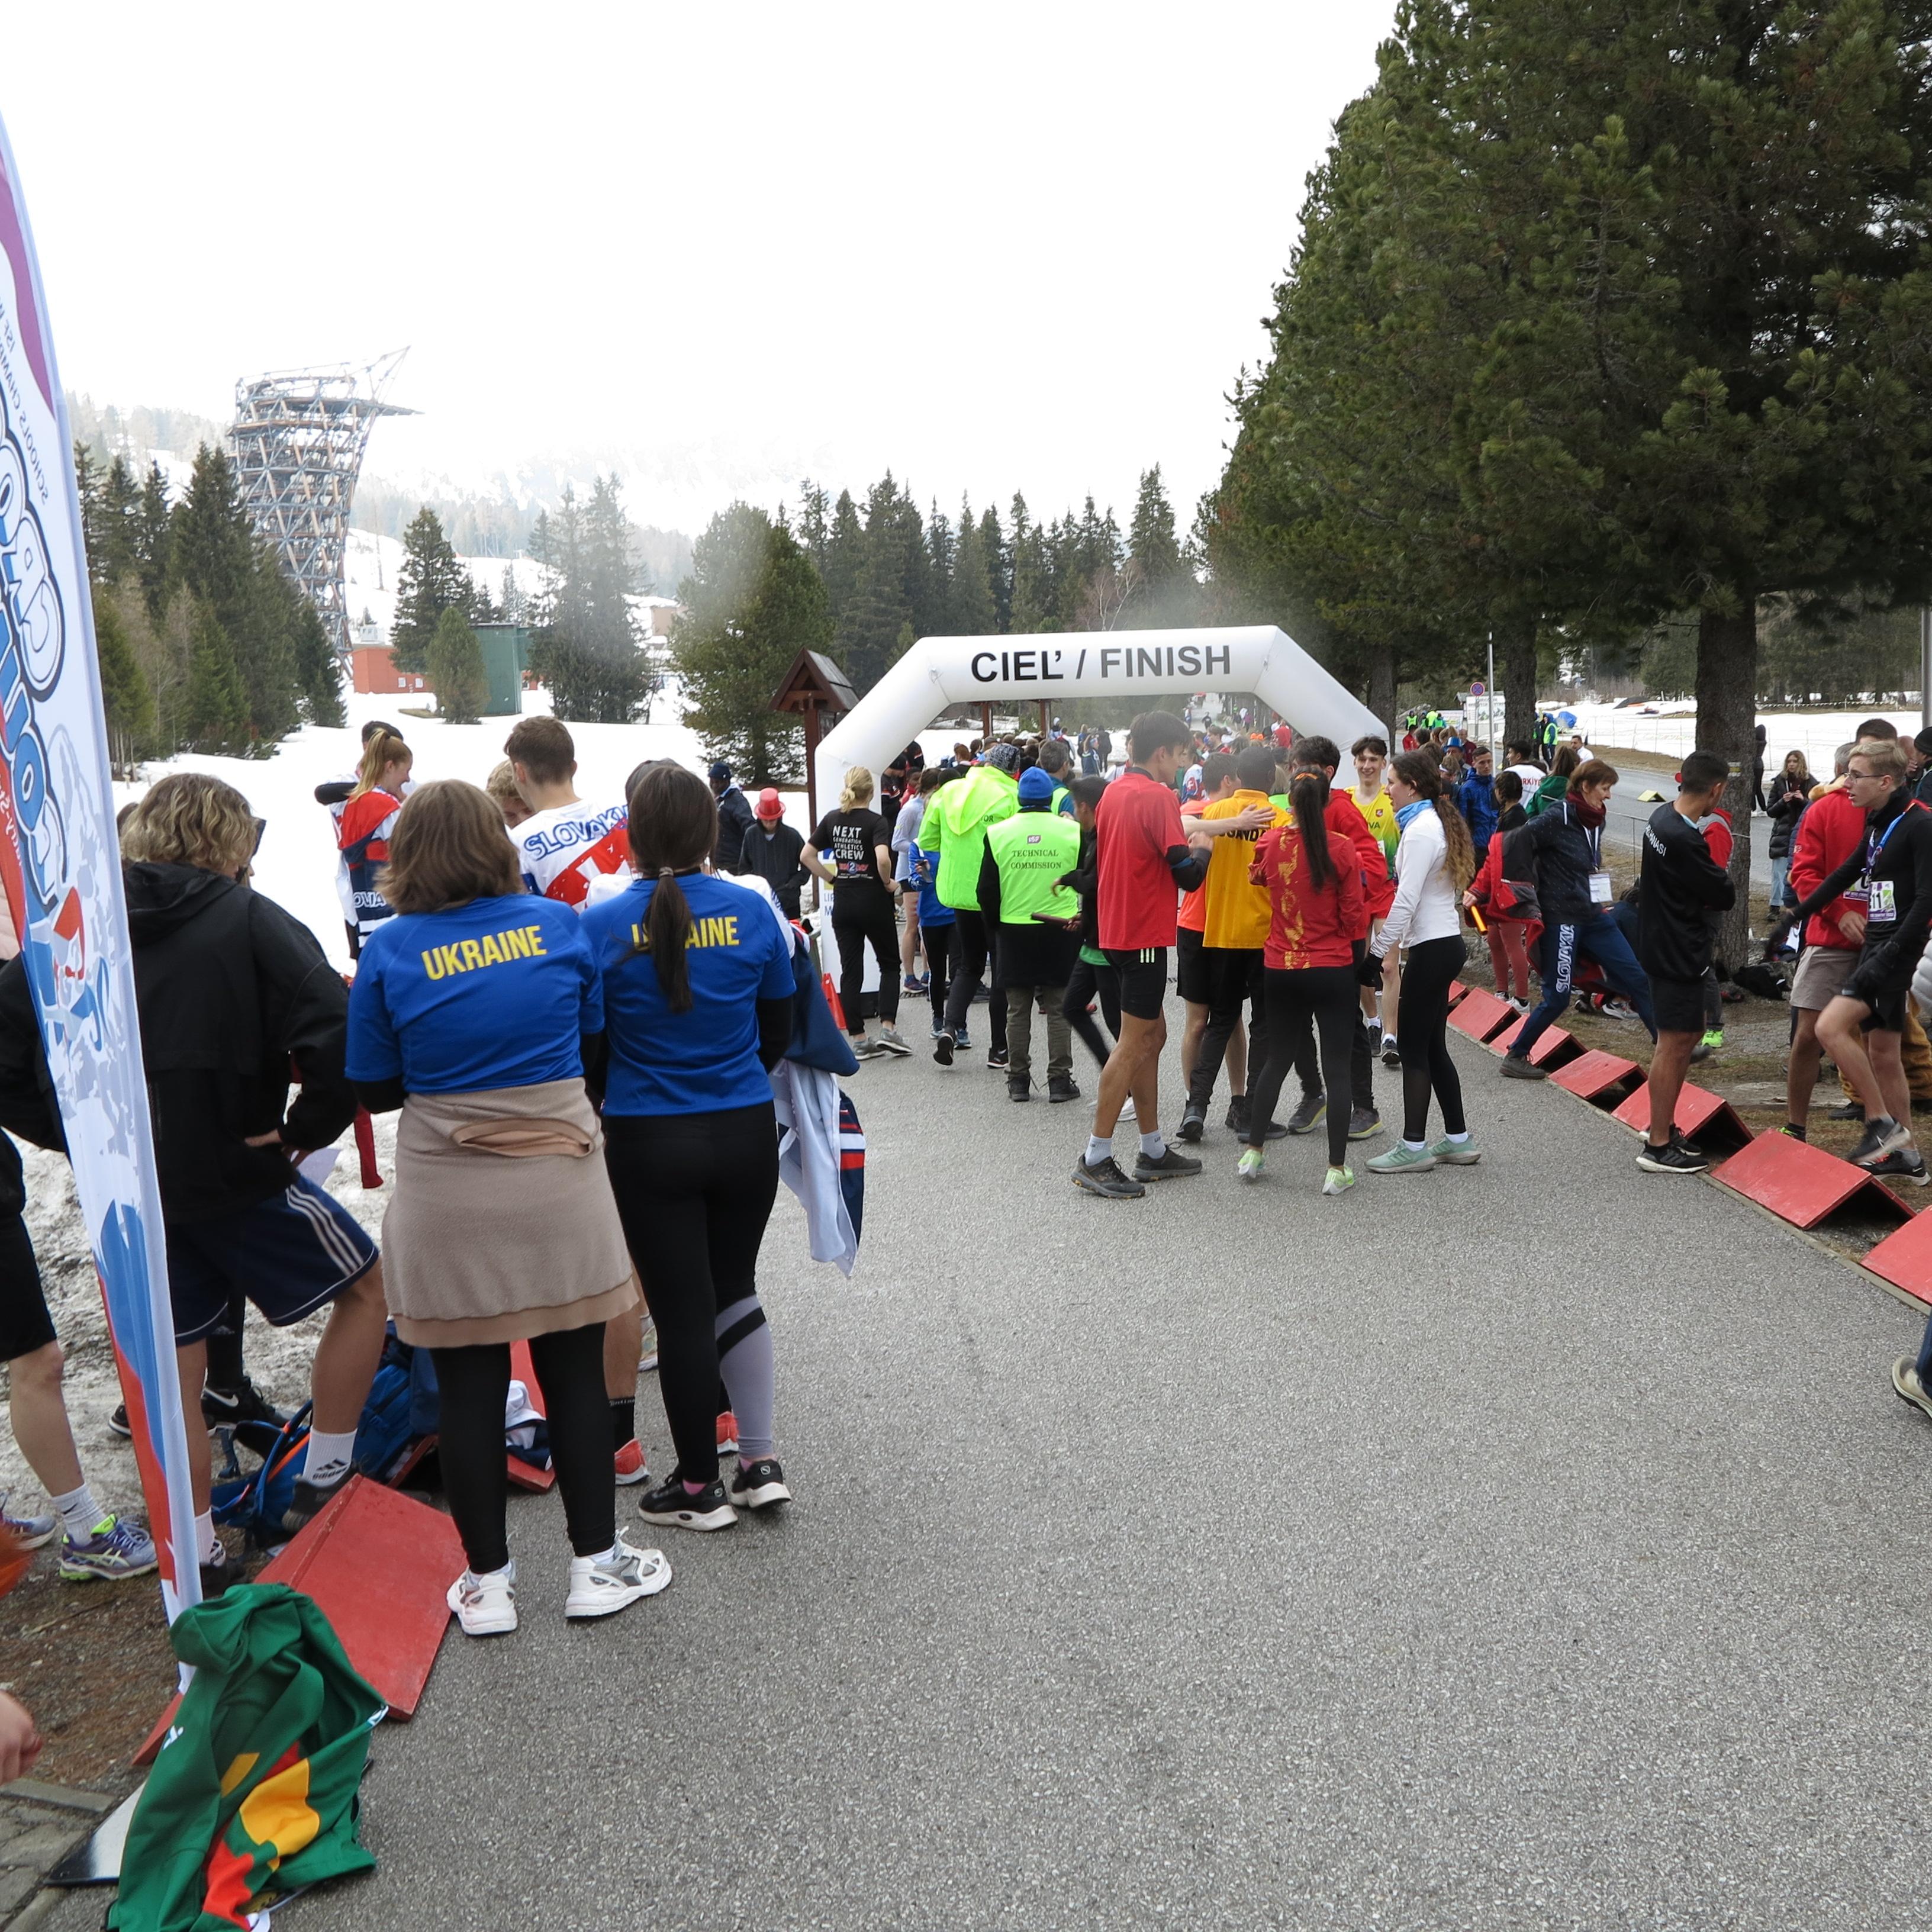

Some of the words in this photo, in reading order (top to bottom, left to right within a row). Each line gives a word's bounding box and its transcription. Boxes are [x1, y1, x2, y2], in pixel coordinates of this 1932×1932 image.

[1076, 649, 1087, 680] /
[1100, 645, 1231, 678] FINISH
[524, 805, 629, 861] SLOVAKI
[832, 825, 862, 838] NEXT
[835, 849, 864, 860] CREW
[1010, 861, 1062, 870] COMMISSION
[421, 925, 548, 981] UKRAINE
